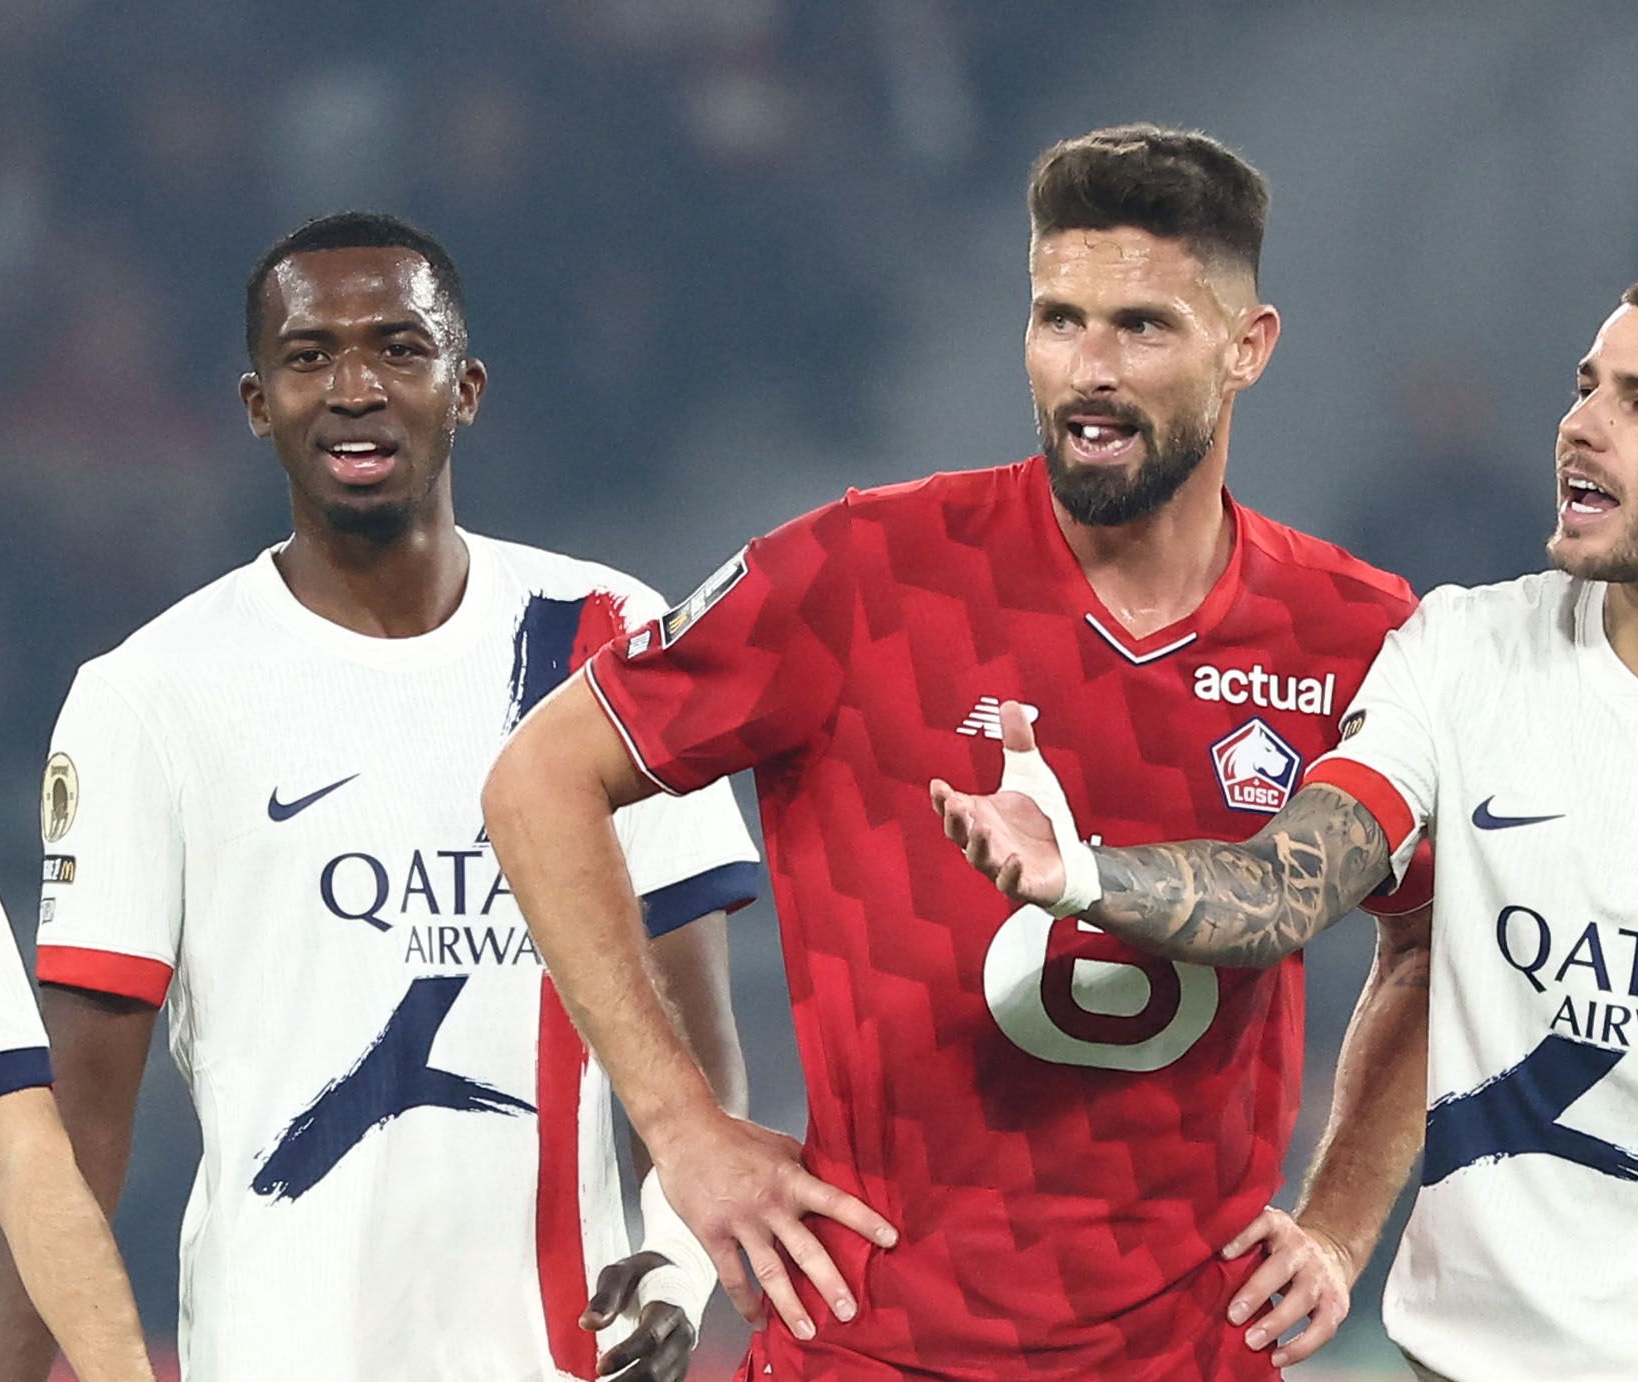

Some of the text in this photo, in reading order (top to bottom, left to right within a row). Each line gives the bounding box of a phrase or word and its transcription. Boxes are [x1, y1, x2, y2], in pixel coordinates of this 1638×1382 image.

[1194, 664, 1335, 716] actual
[1234, 785, 1280, 805] LOSC
[320, 849, 512, 933] QAT
[405, 925, 543, 965] AIRWA
